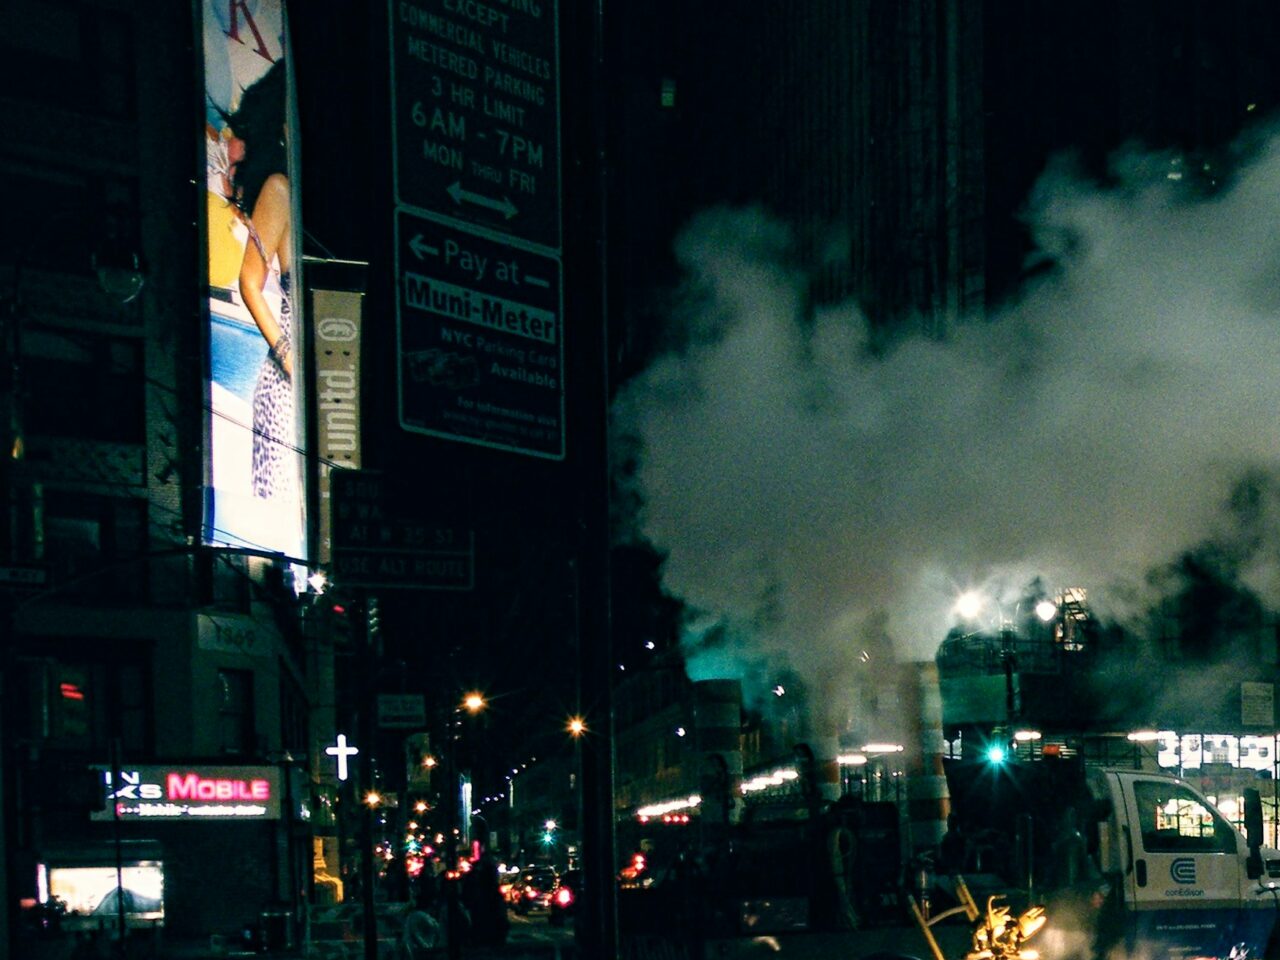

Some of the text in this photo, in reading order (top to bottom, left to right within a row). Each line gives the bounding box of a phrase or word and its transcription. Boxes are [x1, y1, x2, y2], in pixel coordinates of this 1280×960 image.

[400, 2, 551, 80] COMMERCIAL VEHICLES
[408, 35, 545, 106] METERED PARKING
[432, 75, 525, 127] 3 HR LIMIT
[423, 138, 536, 194] MON THRU FRI
[445, 239, 520, 285] Pay at
[409, 276, 554, 339] Muni-Meter
[441, 327, 473, 348] NYC
[476, 336, 525, 364] Parking
[490, 361, 557, 389] Available
